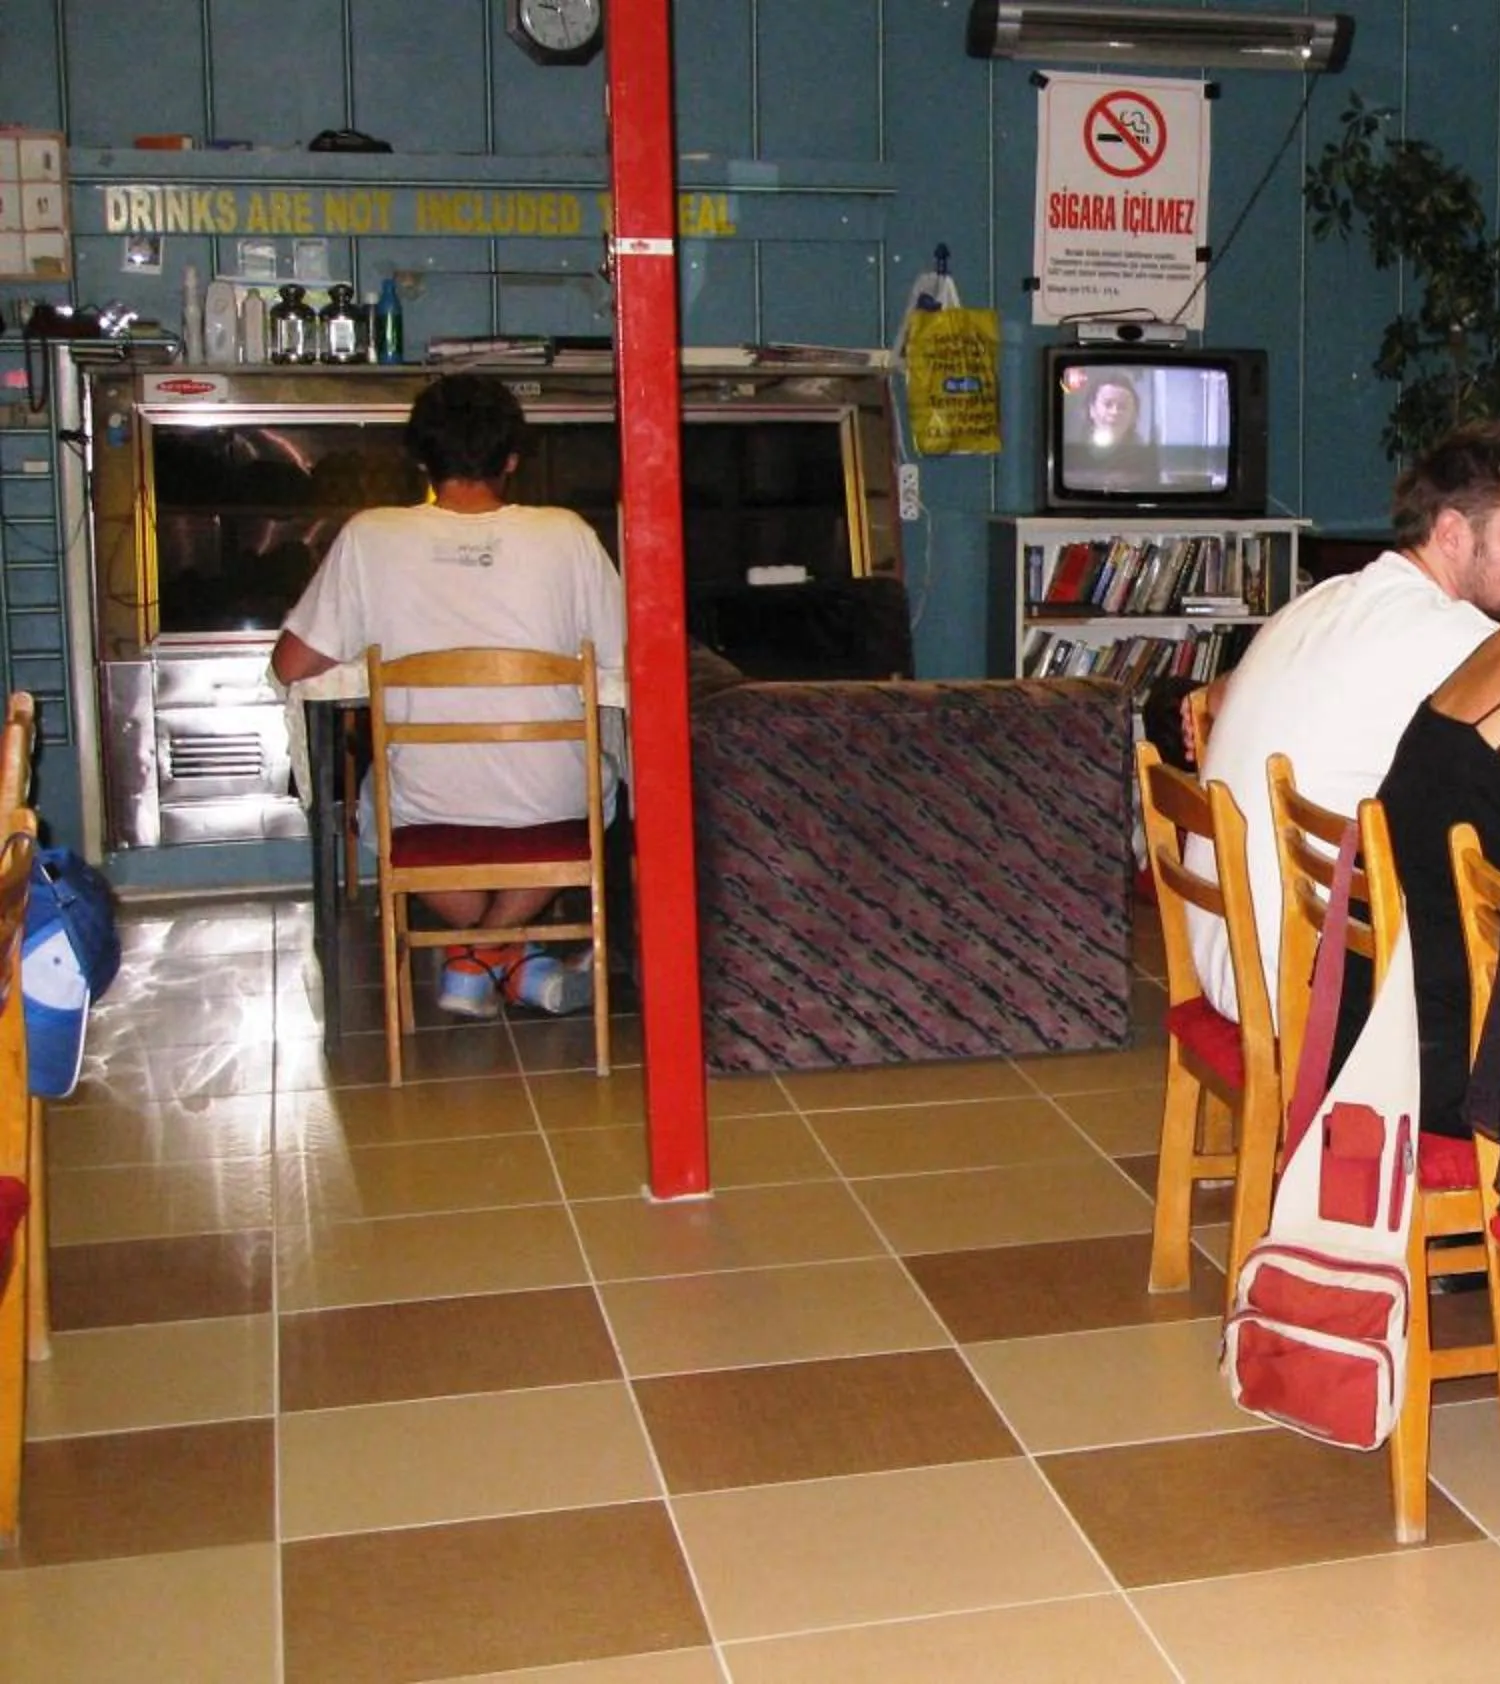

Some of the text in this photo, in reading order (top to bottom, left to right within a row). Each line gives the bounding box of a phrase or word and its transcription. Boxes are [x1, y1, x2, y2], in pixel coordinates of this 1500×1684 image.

[105, 187, 239, 233] DRINKS
[247, 190, 314, 233] ARE
[325, 189, 393, 232] NOT
[415, 191, 582, 233] INCLUDED
[680, 192, 737, 236] EAL
[1049, 186, 1195, 238] SİGARA İÇİLMEZ
